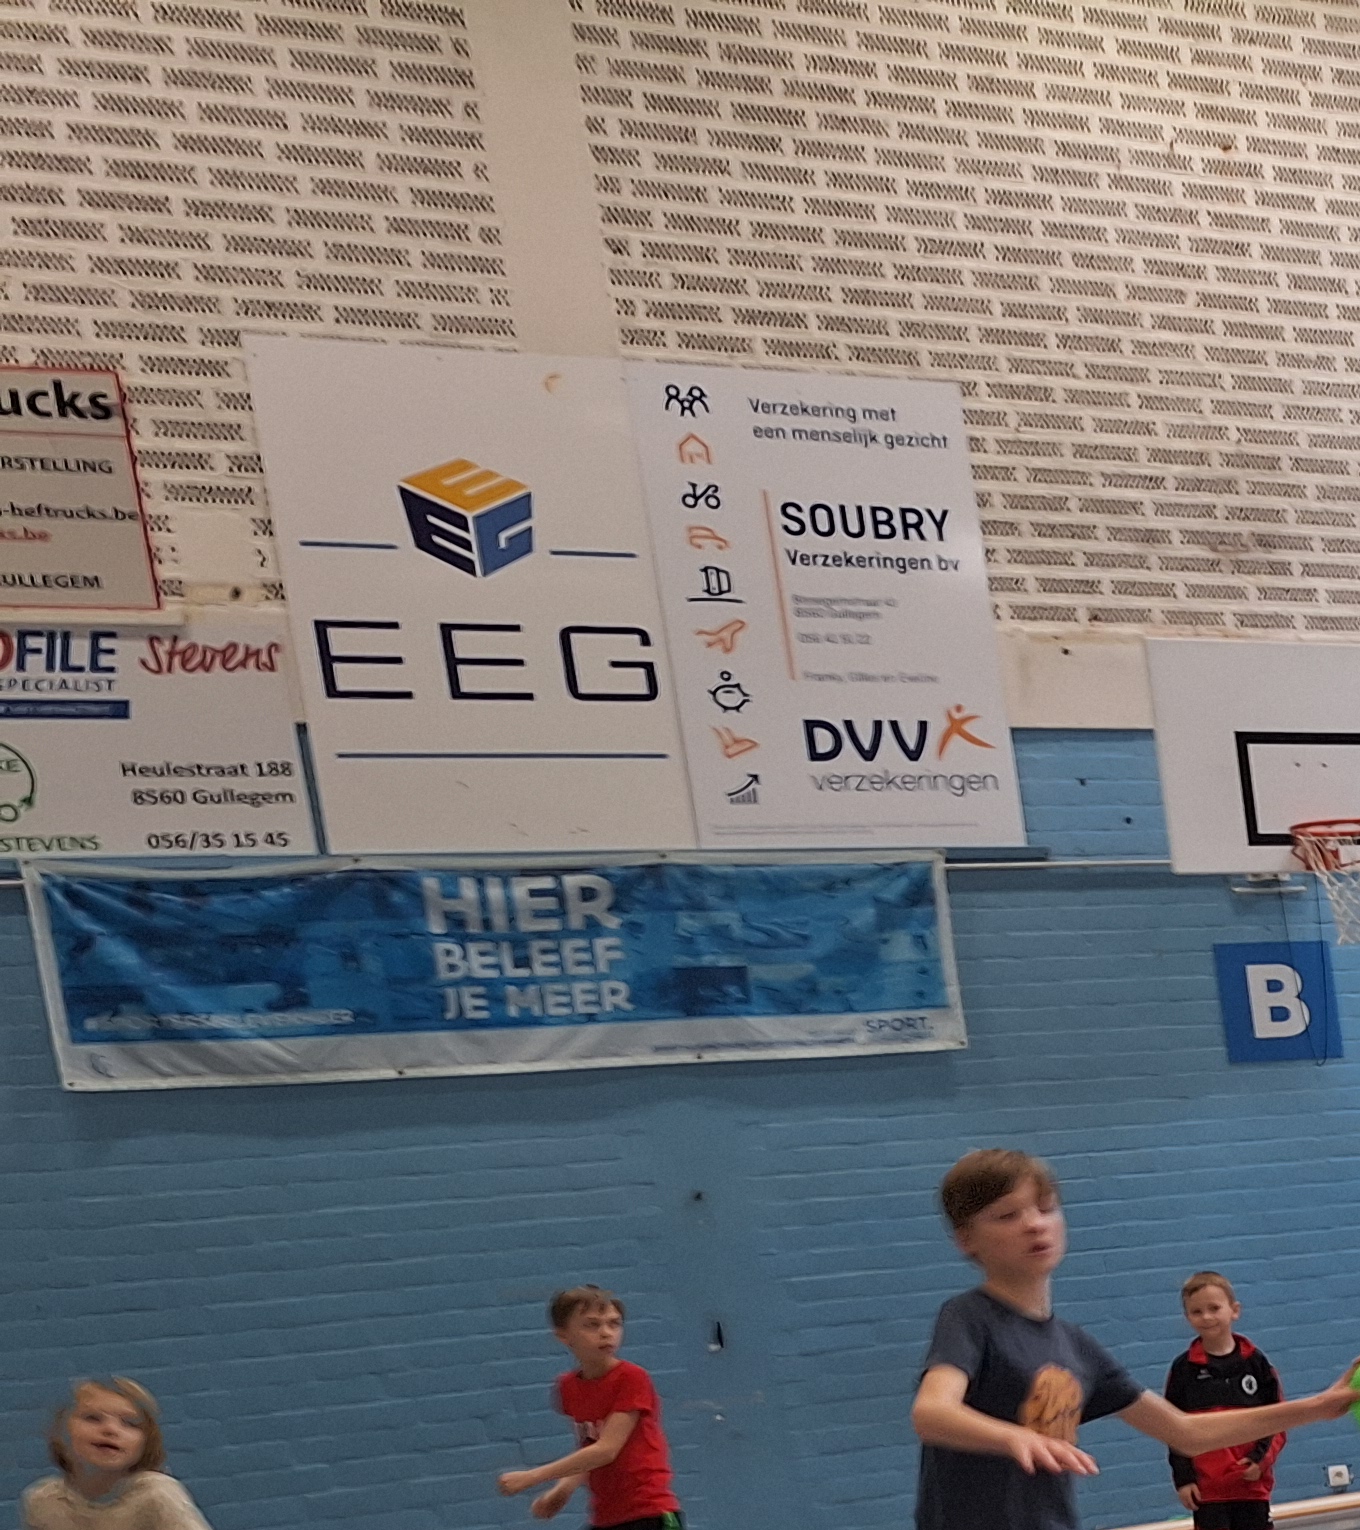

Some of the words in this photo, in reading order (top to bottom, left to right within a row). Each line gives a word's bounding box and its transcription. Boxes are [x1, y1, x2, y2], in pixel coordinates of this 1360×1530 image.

[748, 397, 856, 423] Verzekering
[862, 407, 896, 422] met
[753, 425, 786, 439] een
[792, 427, 878, 449] menselijk
[884, 434, 949, 450] gezicht
[0, 501, 139, 521] -heftrucks.be
[780, 502, 950, 541] SOUBRY
[785, 549, 932, 575] Verzekeringen
[937, 558, 960, 572] bv
[139, 635, 281, 675] Stevens
[314, 620, 659, 702] EEG
[803, 718, 928, 762] DVV
[120, 761, 250, 778] Heulestraat
[256, 762, 294, 778] 188
[810, 770, 999, 797] verzekeringen
[132, 789, 186, 804] 8560
[193, 789, 296, 808] Gullegem
[147, 832, 225, 850] 056/35
[233, 833, 257, 848] 15
[263, 833, 290, 848] 45
[421, 873, 624, 934] HIER
[433, 937, 626, 980] BELEEF
[443, 985, 491, 1020] JE
[505, 980, 637, 1018] MEER
[1245, 963, 1311, 1039] B
